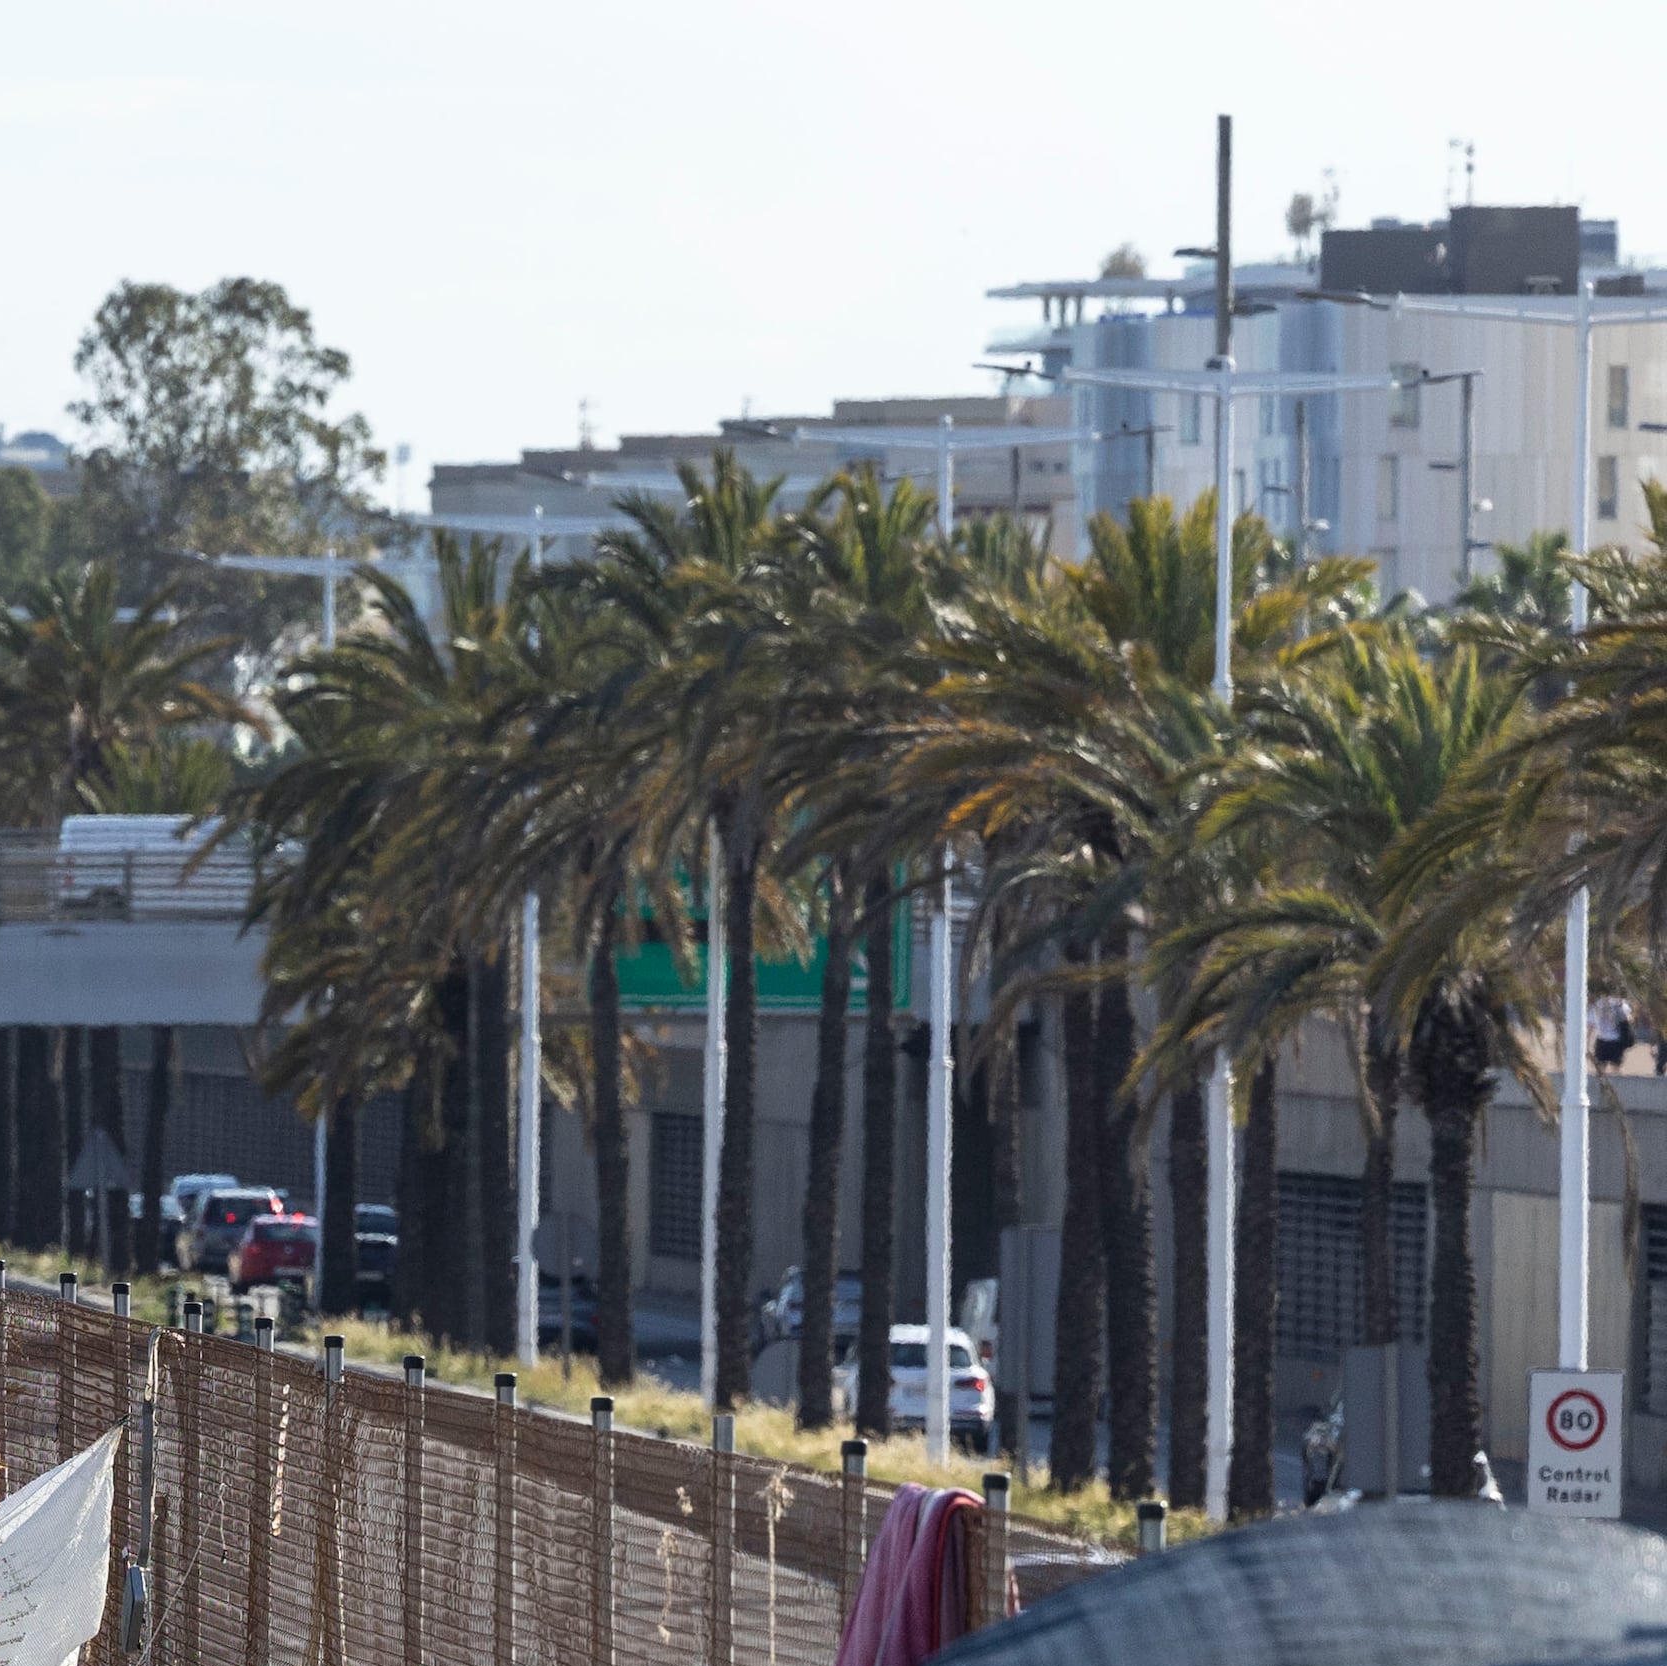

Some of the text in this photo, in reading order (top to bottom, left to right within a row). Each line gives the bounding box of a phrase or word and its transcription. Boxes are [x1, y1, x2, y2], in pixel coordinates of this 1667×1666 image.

[1560, 1410, 1593, 1430] 80
[1538, 1465, 1611, 1482] Control
[1547, 1486, 1601, 1503] Radar
